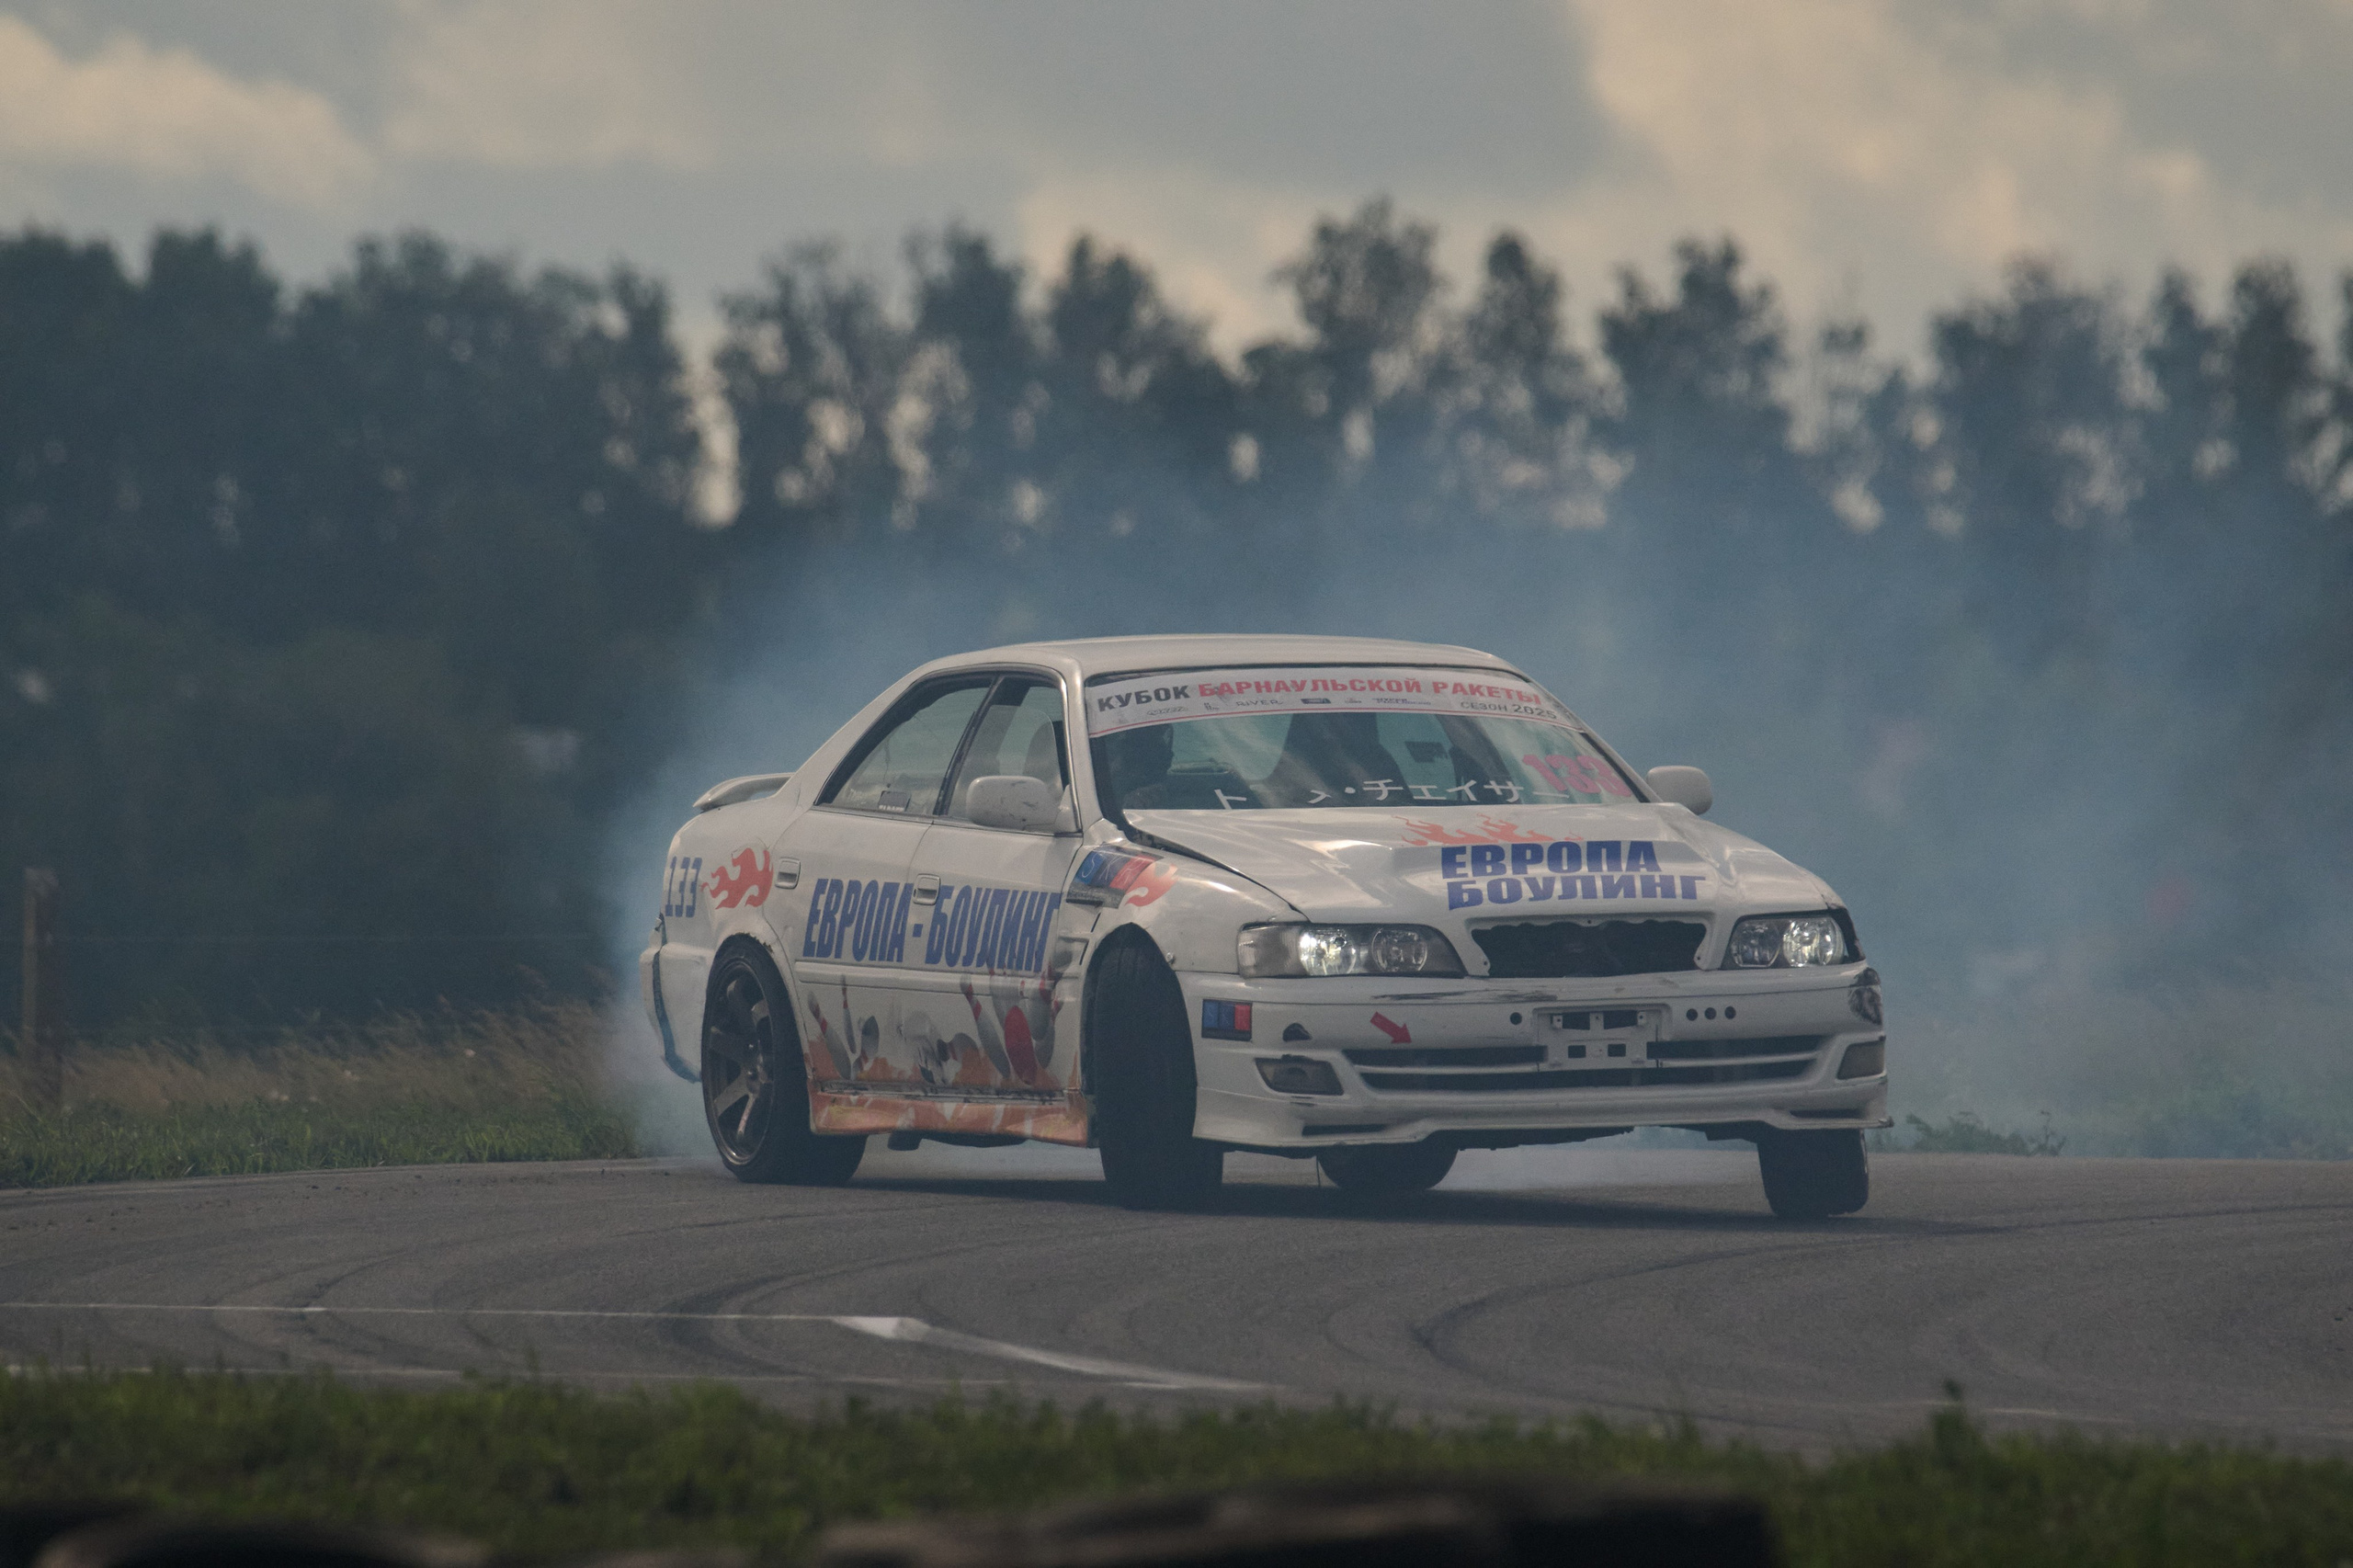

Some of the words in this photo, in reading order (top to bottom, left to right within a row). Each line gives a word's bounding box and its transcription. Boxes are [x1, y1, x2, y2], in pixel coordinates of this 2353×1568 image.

[1097, 684, 1191, 712] КУБОК
[1199, 677, 1422, 698] БАРНАУЛЬСКОЙ
[1432, 681, 1542, 705] РАКЕТЫ
[1461, 700, 1507, 712] СЕЗОН
[1512, 704, 1557, 720] 2025
[1522, 754, 1631, 798] 133
[1441, 840, 1662, 879] ЕВРОПА
[665, 856, 703, 917] 133
[1447, 874, 1706, 911] БОУЛИНГ
